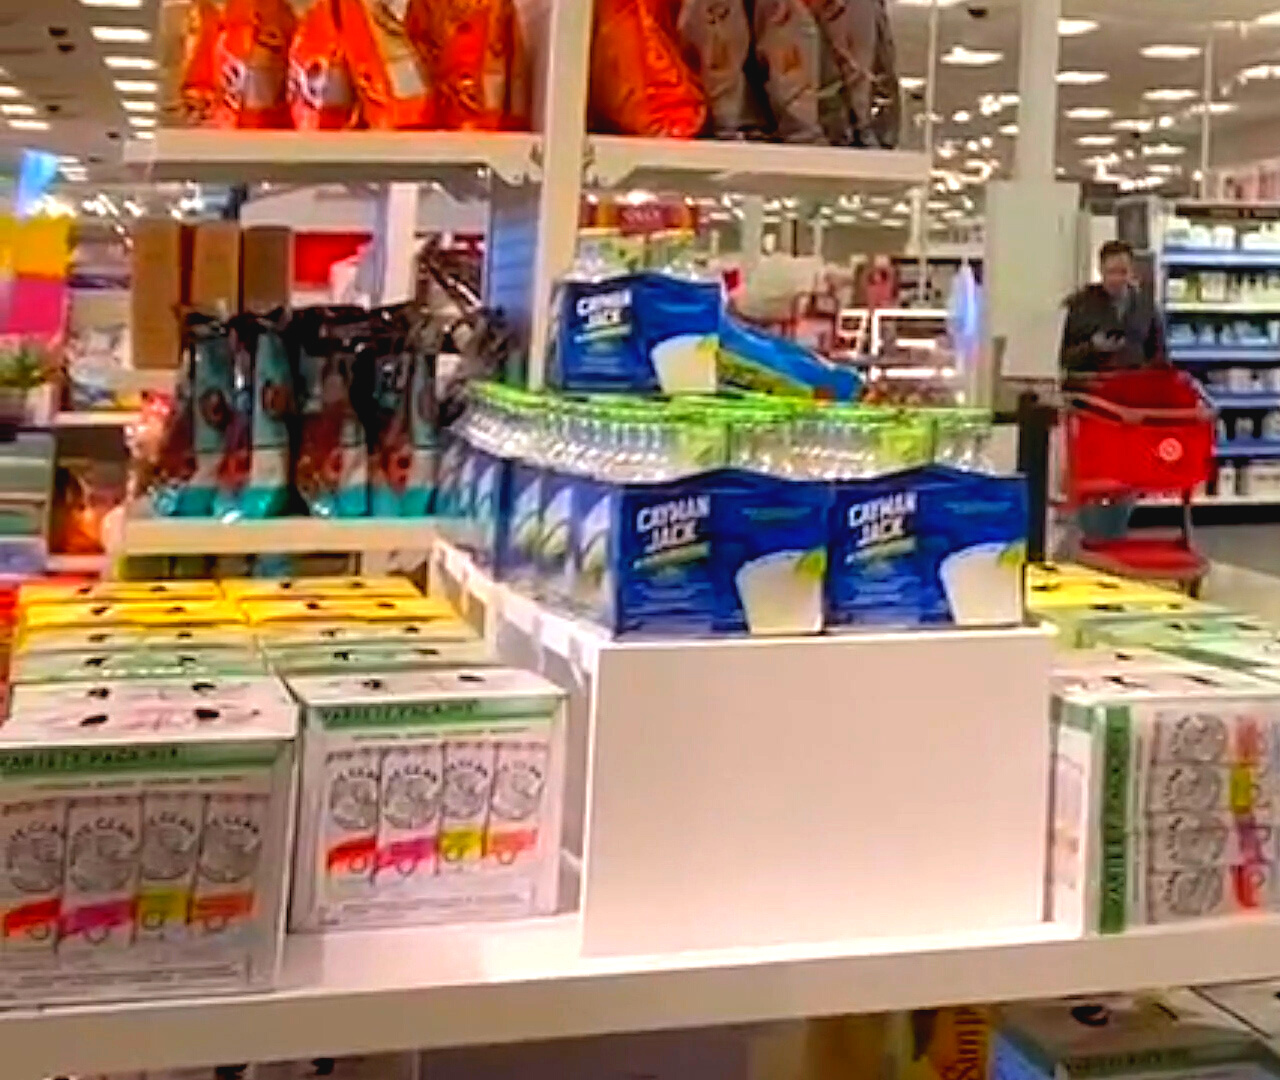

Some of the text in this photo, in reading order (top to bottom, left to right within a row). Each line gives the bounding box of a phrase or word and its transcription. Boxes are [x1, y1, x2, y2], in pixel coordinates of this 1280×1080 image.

[636, 495, 711, 533] CAYMAN
[847, 491, 918, 528] CAYMAN
[643, 520, 698, 554] JACK
[855, 517, 907, 548] JACK
